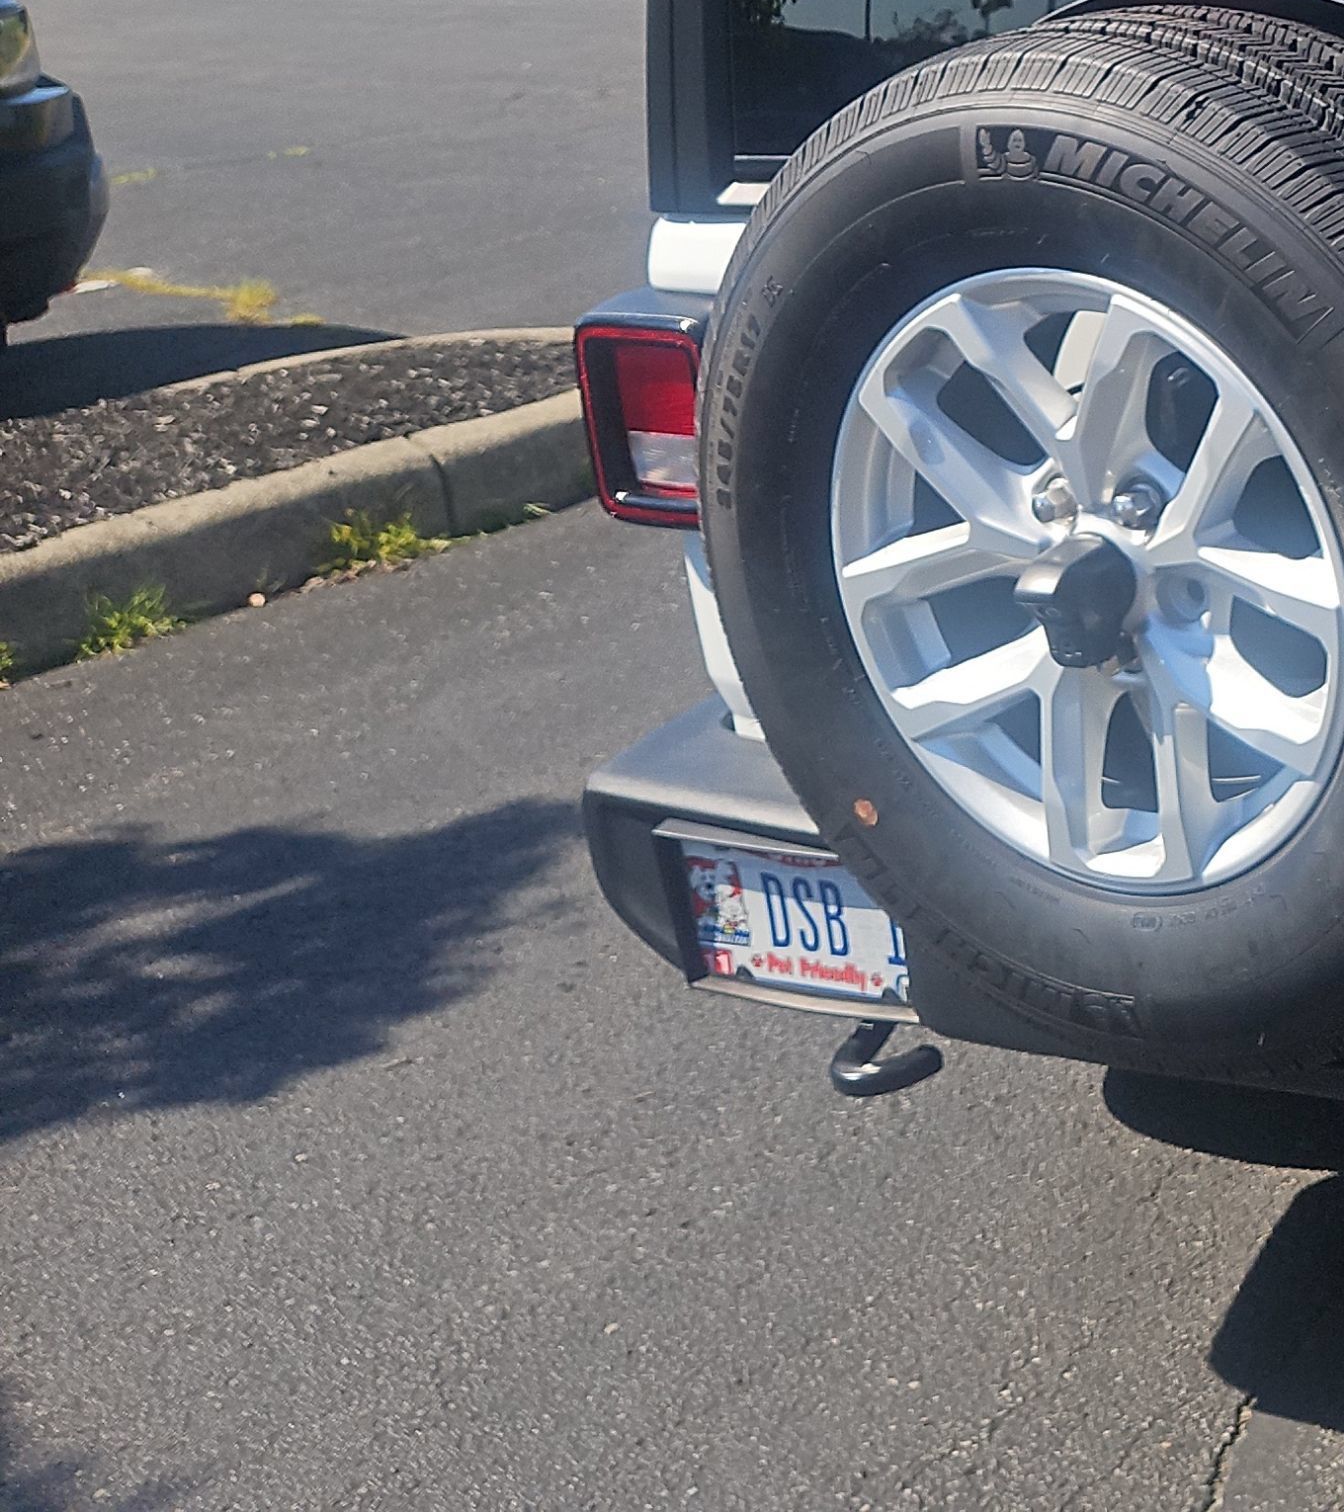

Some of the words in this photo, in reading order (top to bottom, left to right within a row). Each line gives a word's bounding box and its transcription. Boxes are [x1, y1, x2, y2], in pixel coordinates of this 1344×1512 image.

[1044, 134, 1322, 328] MICHELIN
[760, 871, 850, 957] DSB
[767, 952, 793, 974] Pet
[799, 955, 866, 992] Friendly
